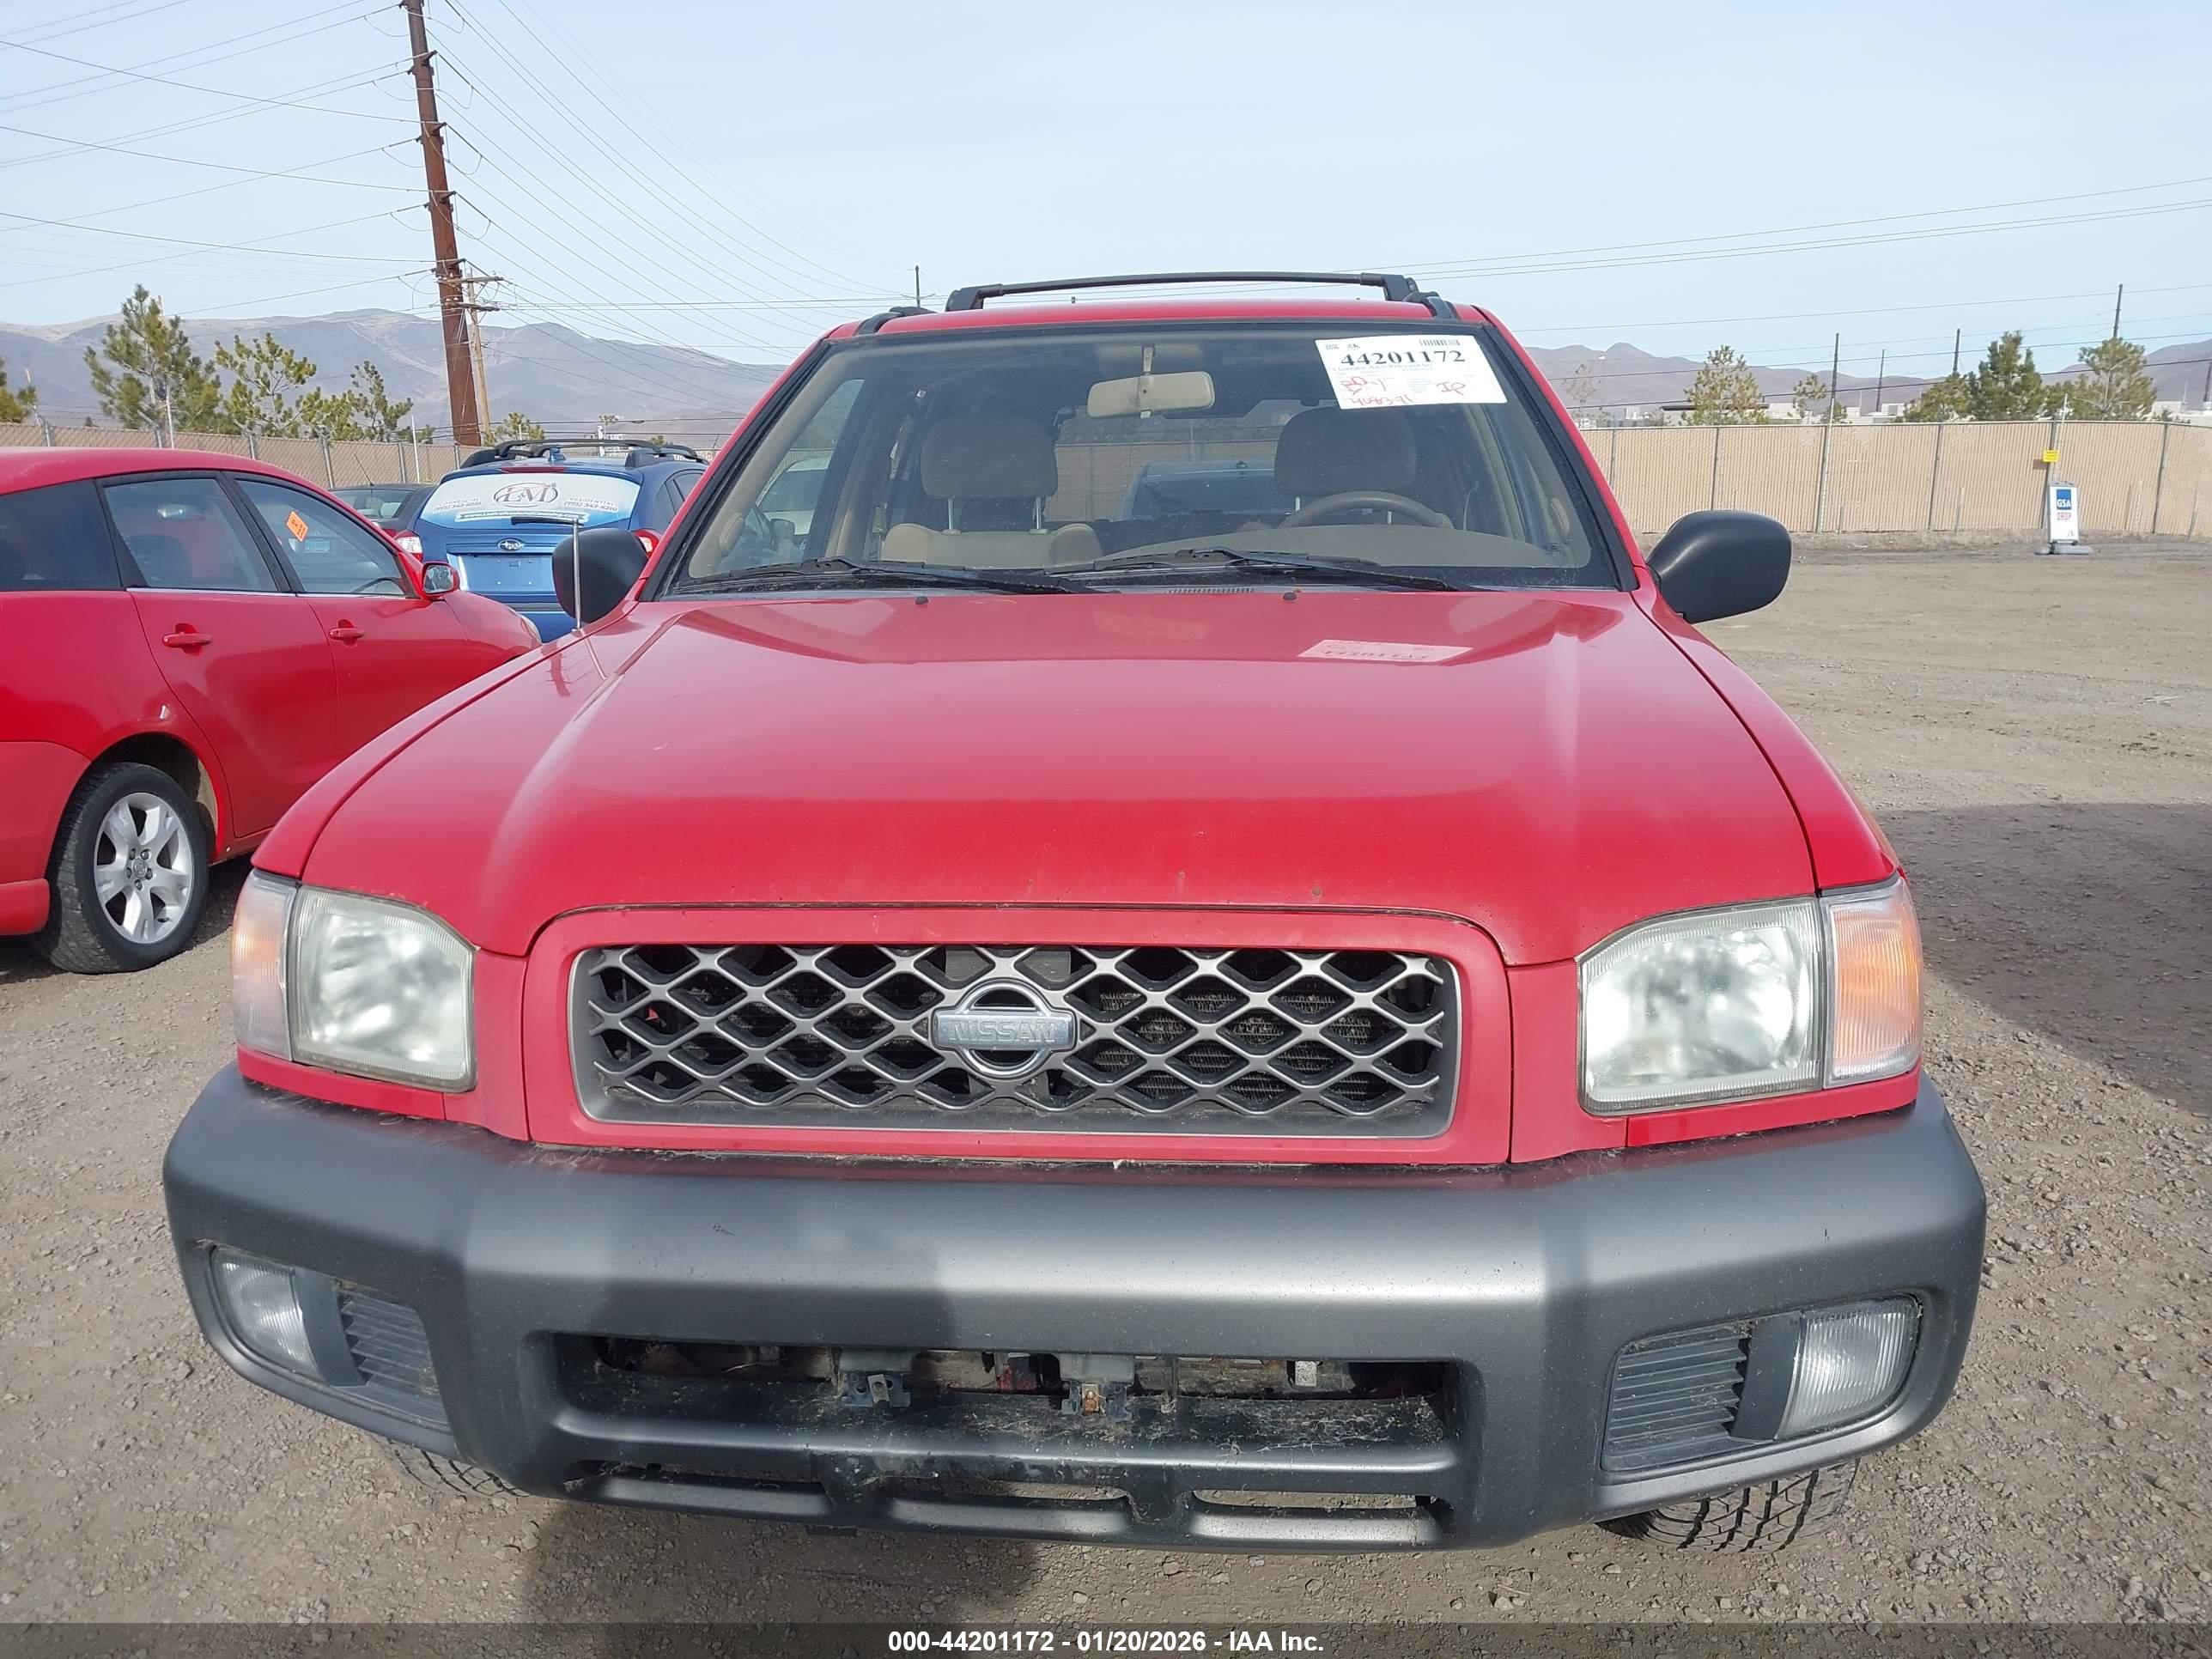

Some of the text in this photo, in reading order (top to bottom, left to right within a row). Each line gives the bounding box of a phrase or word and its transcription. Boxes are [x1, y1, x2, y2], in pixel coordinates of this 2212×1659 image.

[1341, 350, 1465, 366] 44201172
[2057, 499, 2071, 507] GSA
[949, 1019, 1056, 1042] NISSAN
